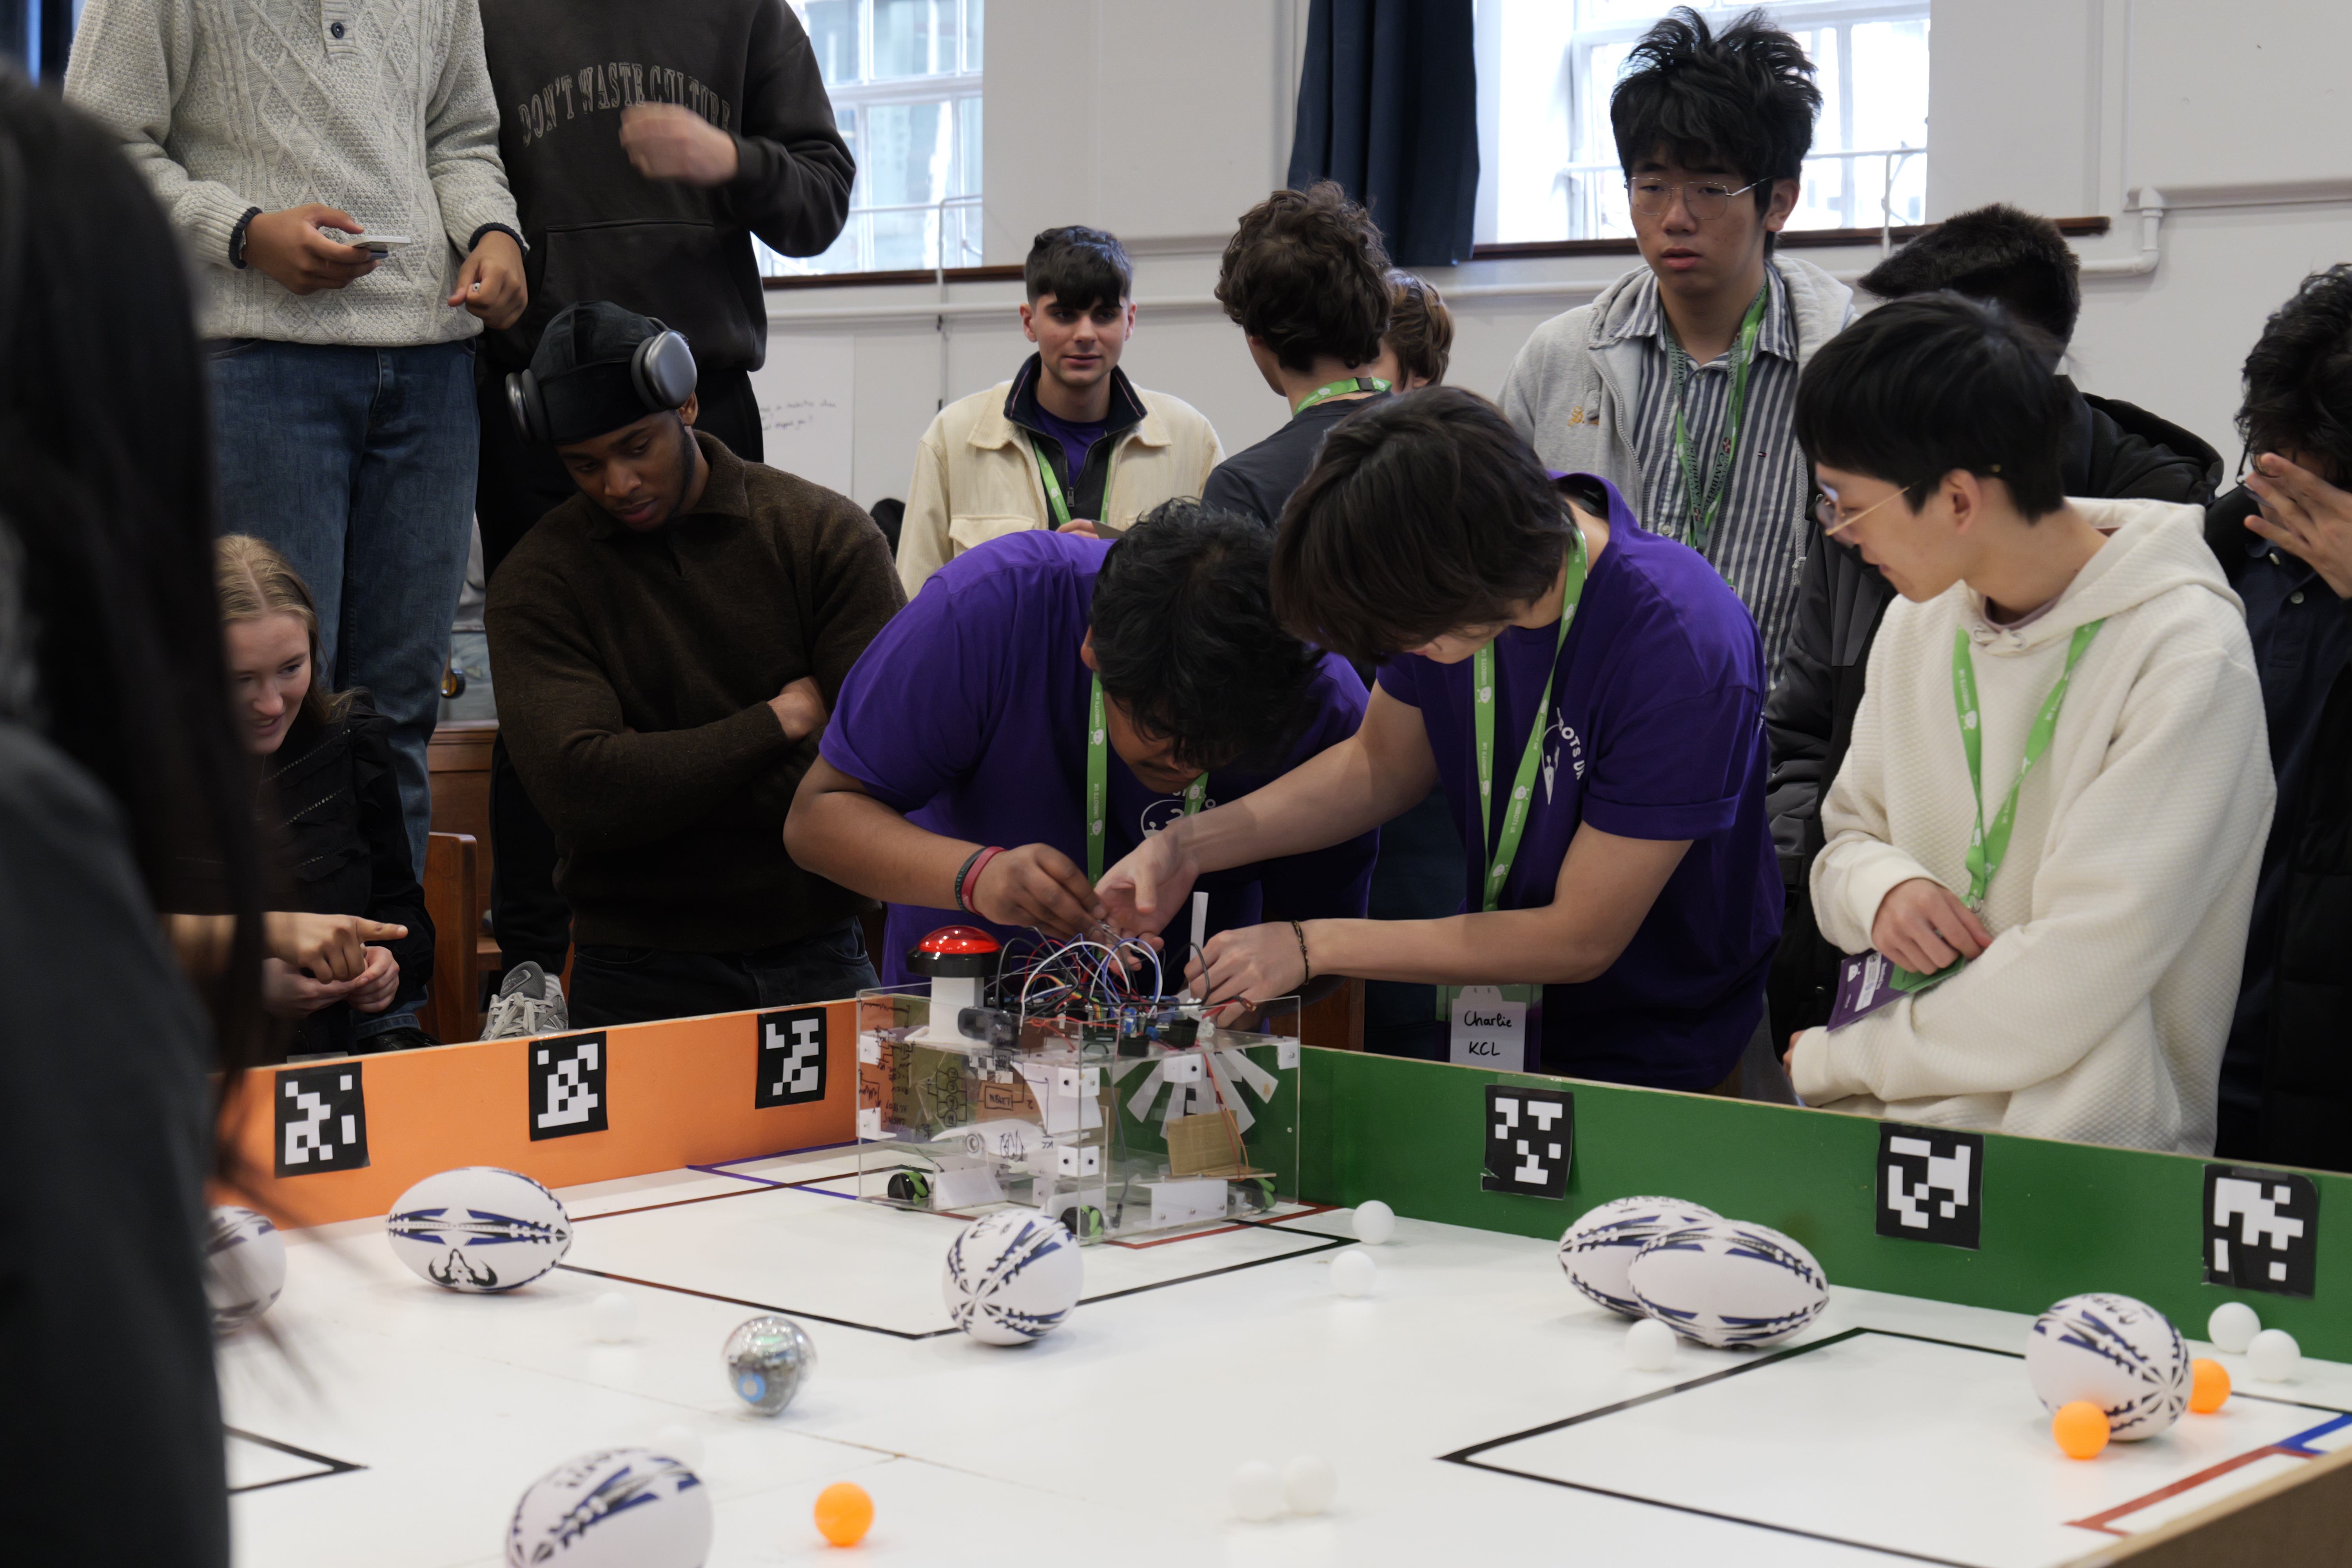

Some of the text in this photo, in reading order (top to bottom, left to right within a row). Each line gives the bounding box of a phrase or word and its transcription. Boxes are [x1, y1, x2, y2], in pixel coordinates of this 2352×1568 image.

[518, 62, 730, 147] DON'T WASTE CULTURE
[1512, 801, 1523, 826] UNIBOTS
[1464, 1010, 1512, 1028] Charlie
[1469, 1041, 1500, 1056] KCL
